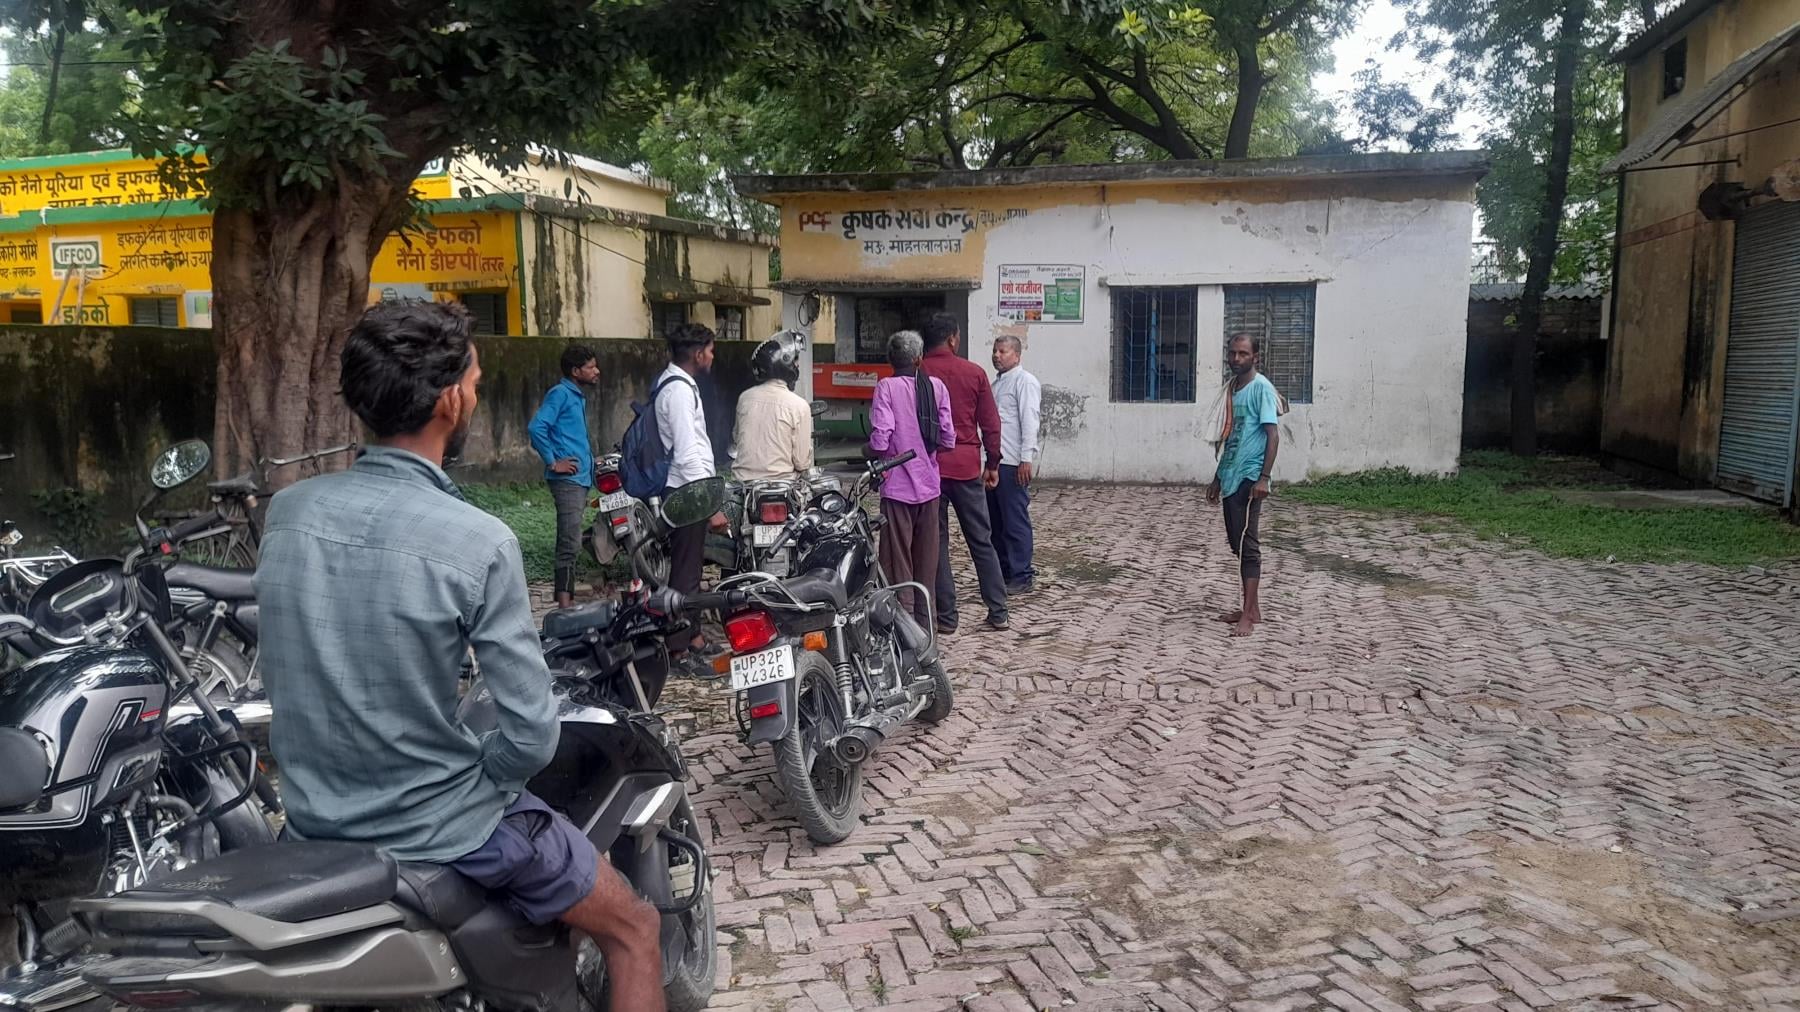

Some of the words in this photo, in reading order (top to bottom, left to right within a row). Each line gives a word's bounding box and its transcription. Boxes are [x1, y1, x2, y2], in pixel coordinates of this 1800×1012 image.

[20, 172, 43, 195] नैनो
[45, 170, 85, 197] यूरिया
[89, 167, 112, 192] एवं
[116, 169, 162, 190] इफक
[425, 219, 482, 249] इफको
[59, 248, 92, 262] IFFCO
[396, 247, 426, 271] नैनो
[429, 246, 479, 271] डीएपी
[740, 649, 783, 671] UP32P
